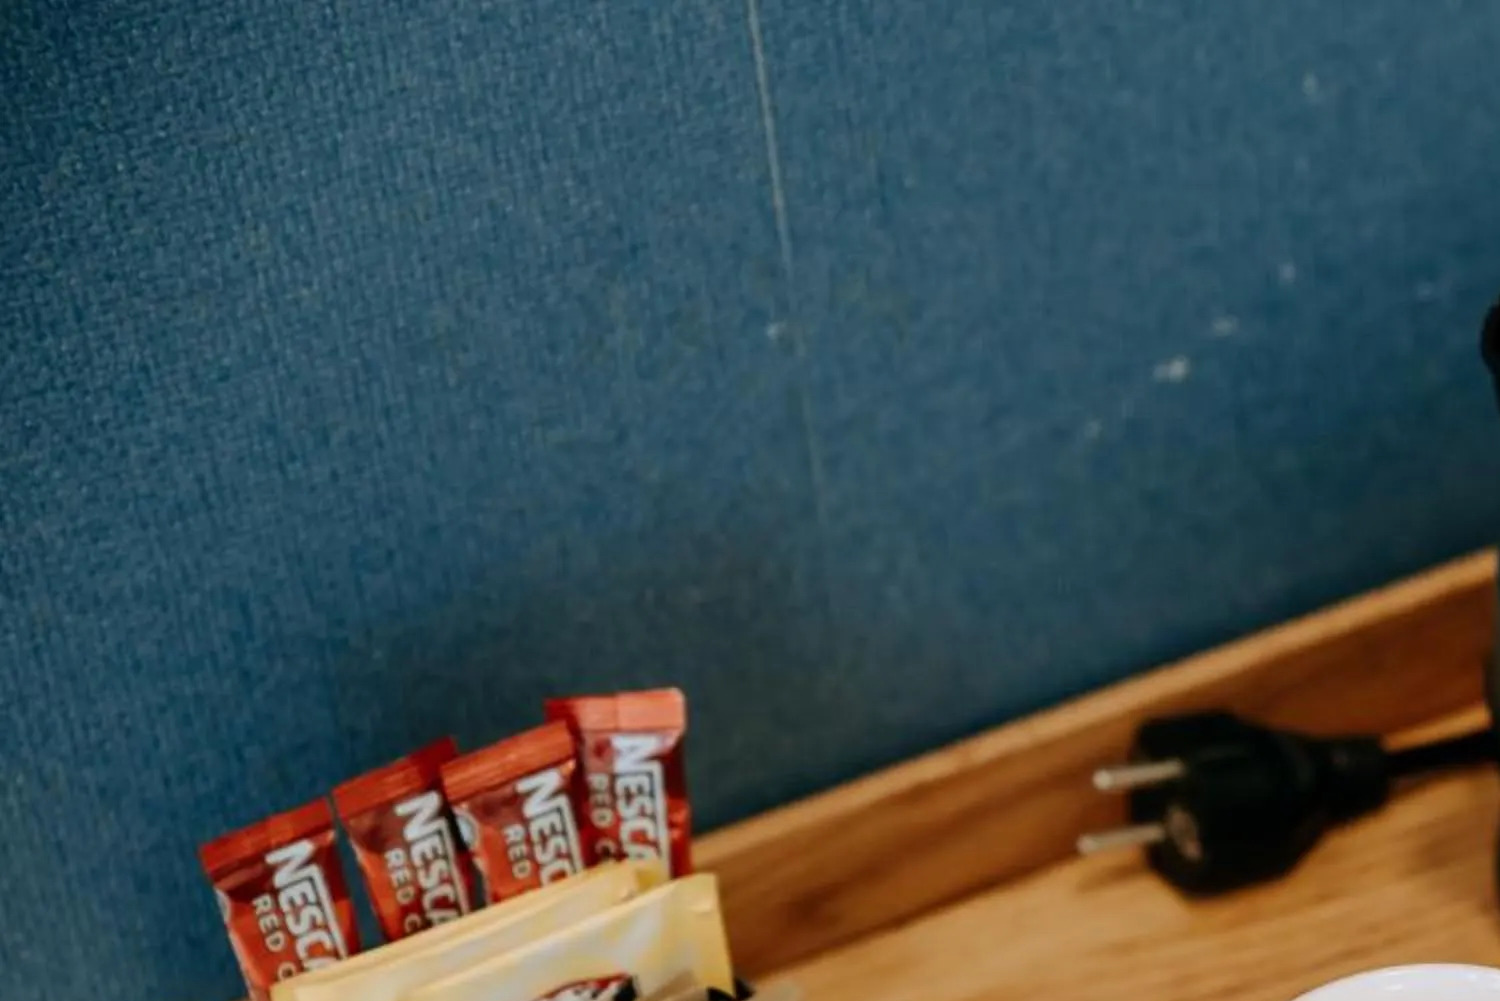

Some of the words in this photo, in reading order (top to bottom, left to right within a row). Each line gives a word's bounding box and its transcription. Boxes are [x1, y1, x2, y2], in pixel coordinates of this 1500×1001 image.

[384, 848, 416, 905] RED
[503, 823, 532, 880] RED
[252, 893, 286, 953] RED
